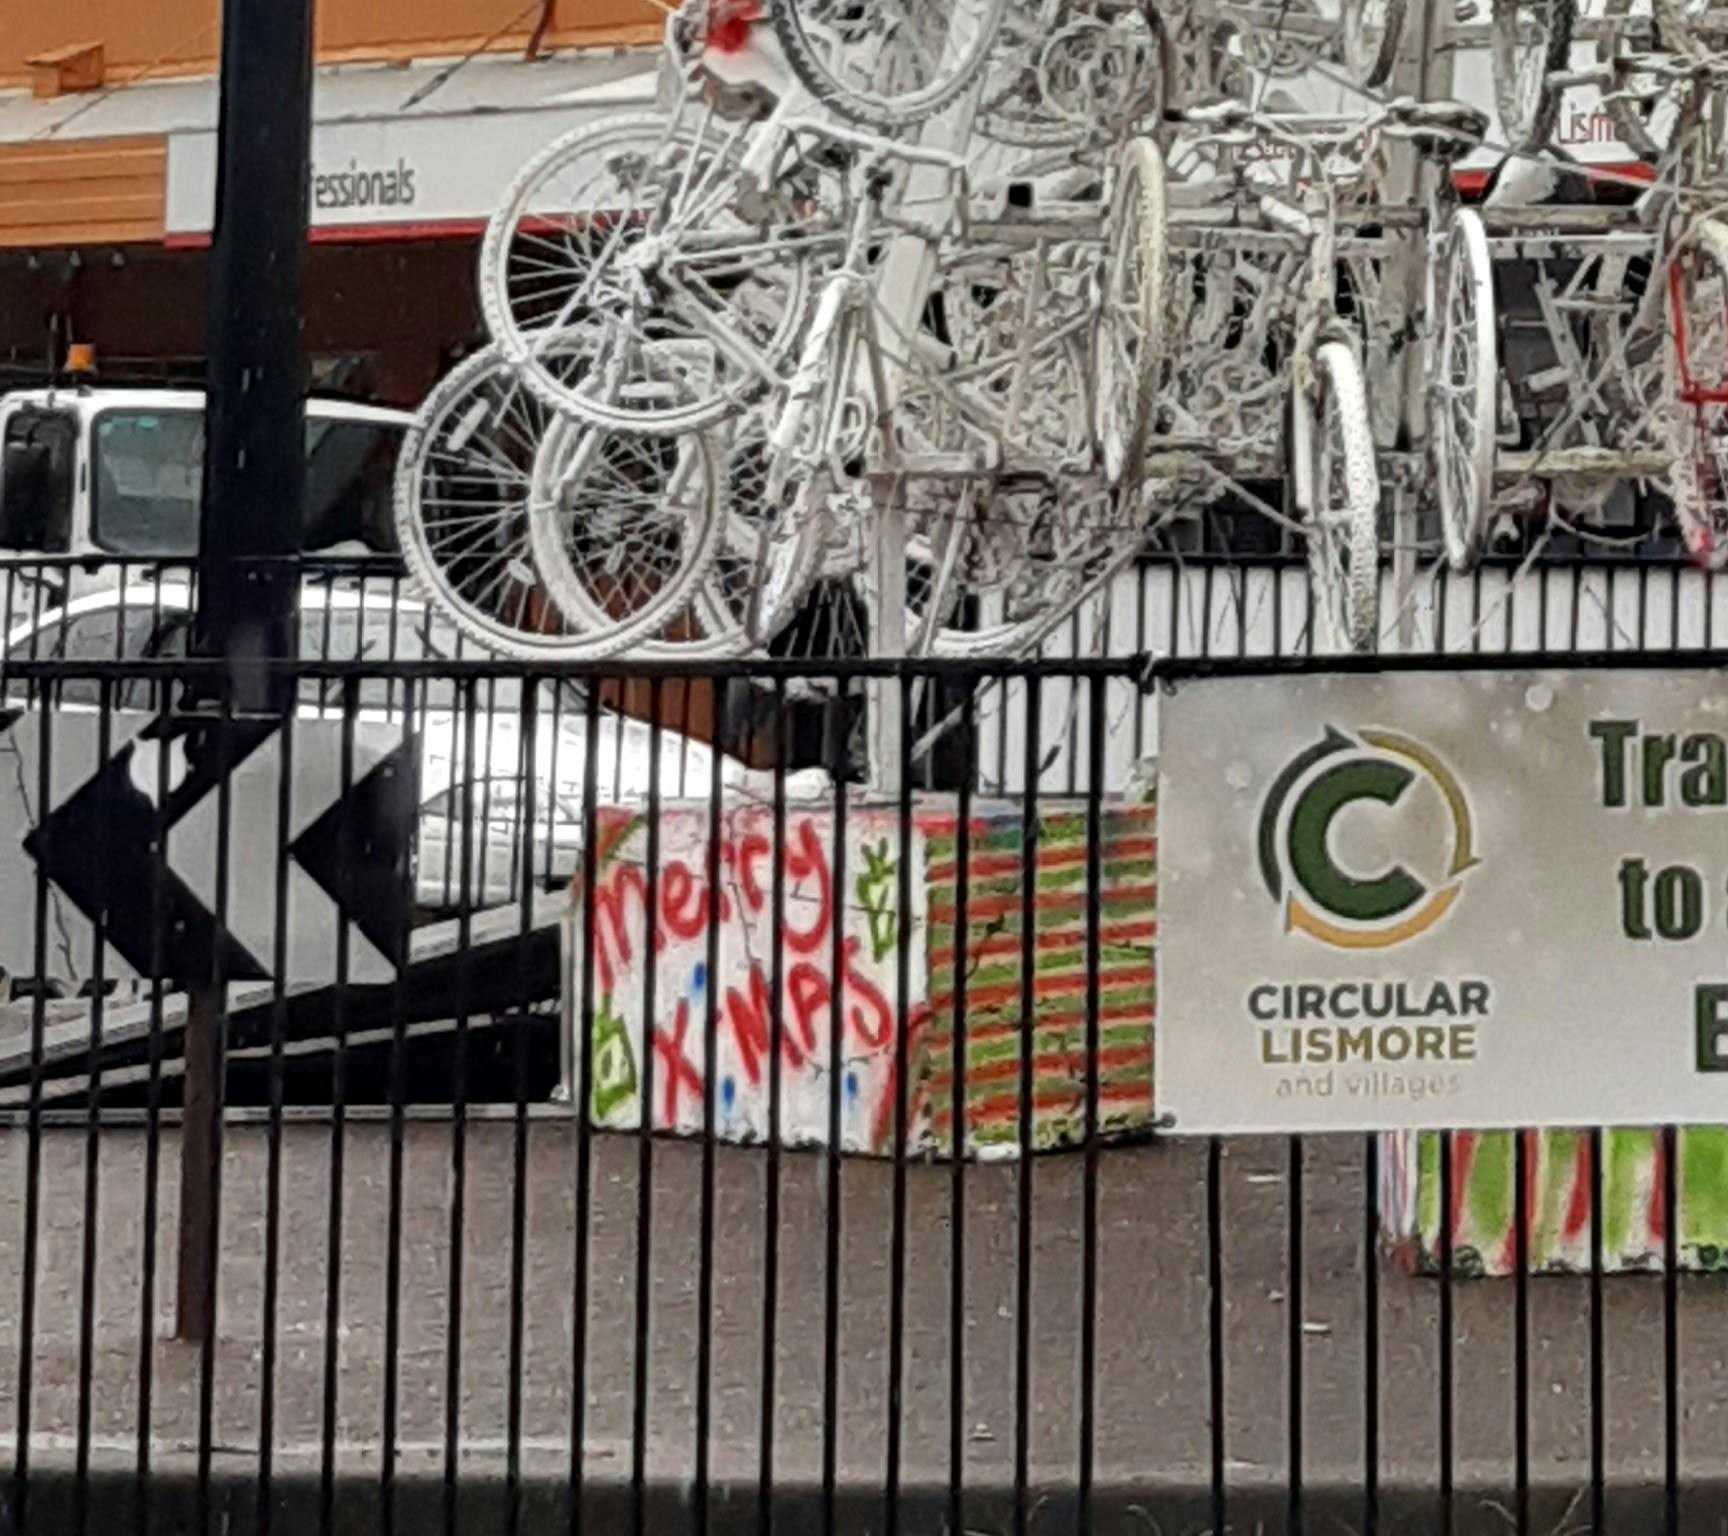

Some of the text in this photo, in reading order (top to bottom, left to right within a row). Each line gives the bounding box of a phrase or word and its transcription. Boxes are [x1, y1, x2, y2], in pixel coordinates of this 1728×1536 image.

[312, 157, 416, 207] essionals
[1618, 857, 1704, 942] to
[1247, 980, 1491, 1021] CIRCULAR
[1261, 1024, 1478, 1064] LISMORE
[1275, 1070, 1462, 1102] and villages
